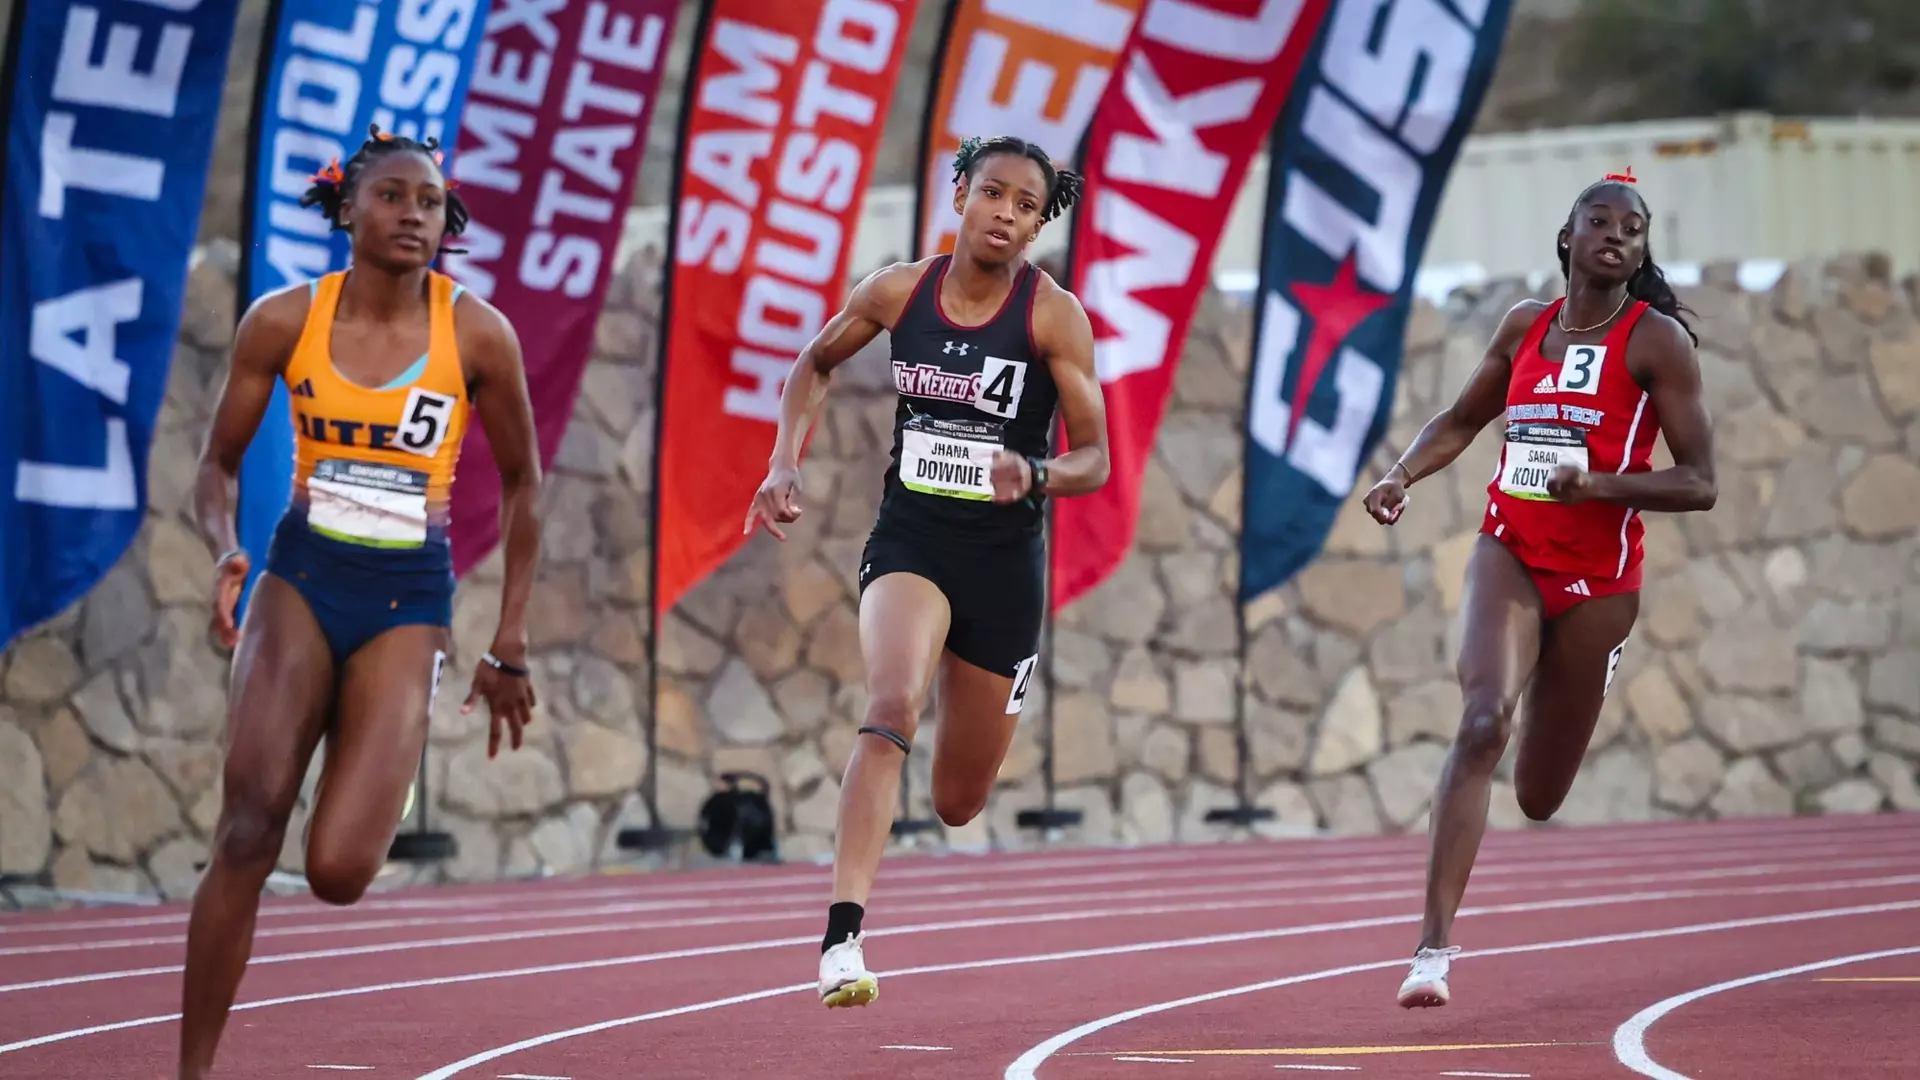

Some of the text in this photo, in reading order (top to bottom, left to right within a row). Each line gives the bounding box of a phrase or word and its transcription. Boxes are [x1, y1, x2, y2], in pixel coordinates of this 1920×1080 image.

[517, 0, 666, 298] STATE
[674, 17, 801, 276] SAM
[15, 0, 200, 510] LA TE
[1566, 347, 1596, 390] 3
[968, 377, 982, 402] S
[983, 364, 1017, 413] 4
[298, 411, 404, 452] UTE
[402, 394, 446, 448] 5
[974, 424, 989, 435] USA
[1561, 404, 1604, 427] TECH
[931, 442, 970, 459] JHANA
[1528, 449, 1558, 464] SARAN
[916, 457, 984, 487] DOWNIE
[1512, 467, 1549, 488] KOUY
